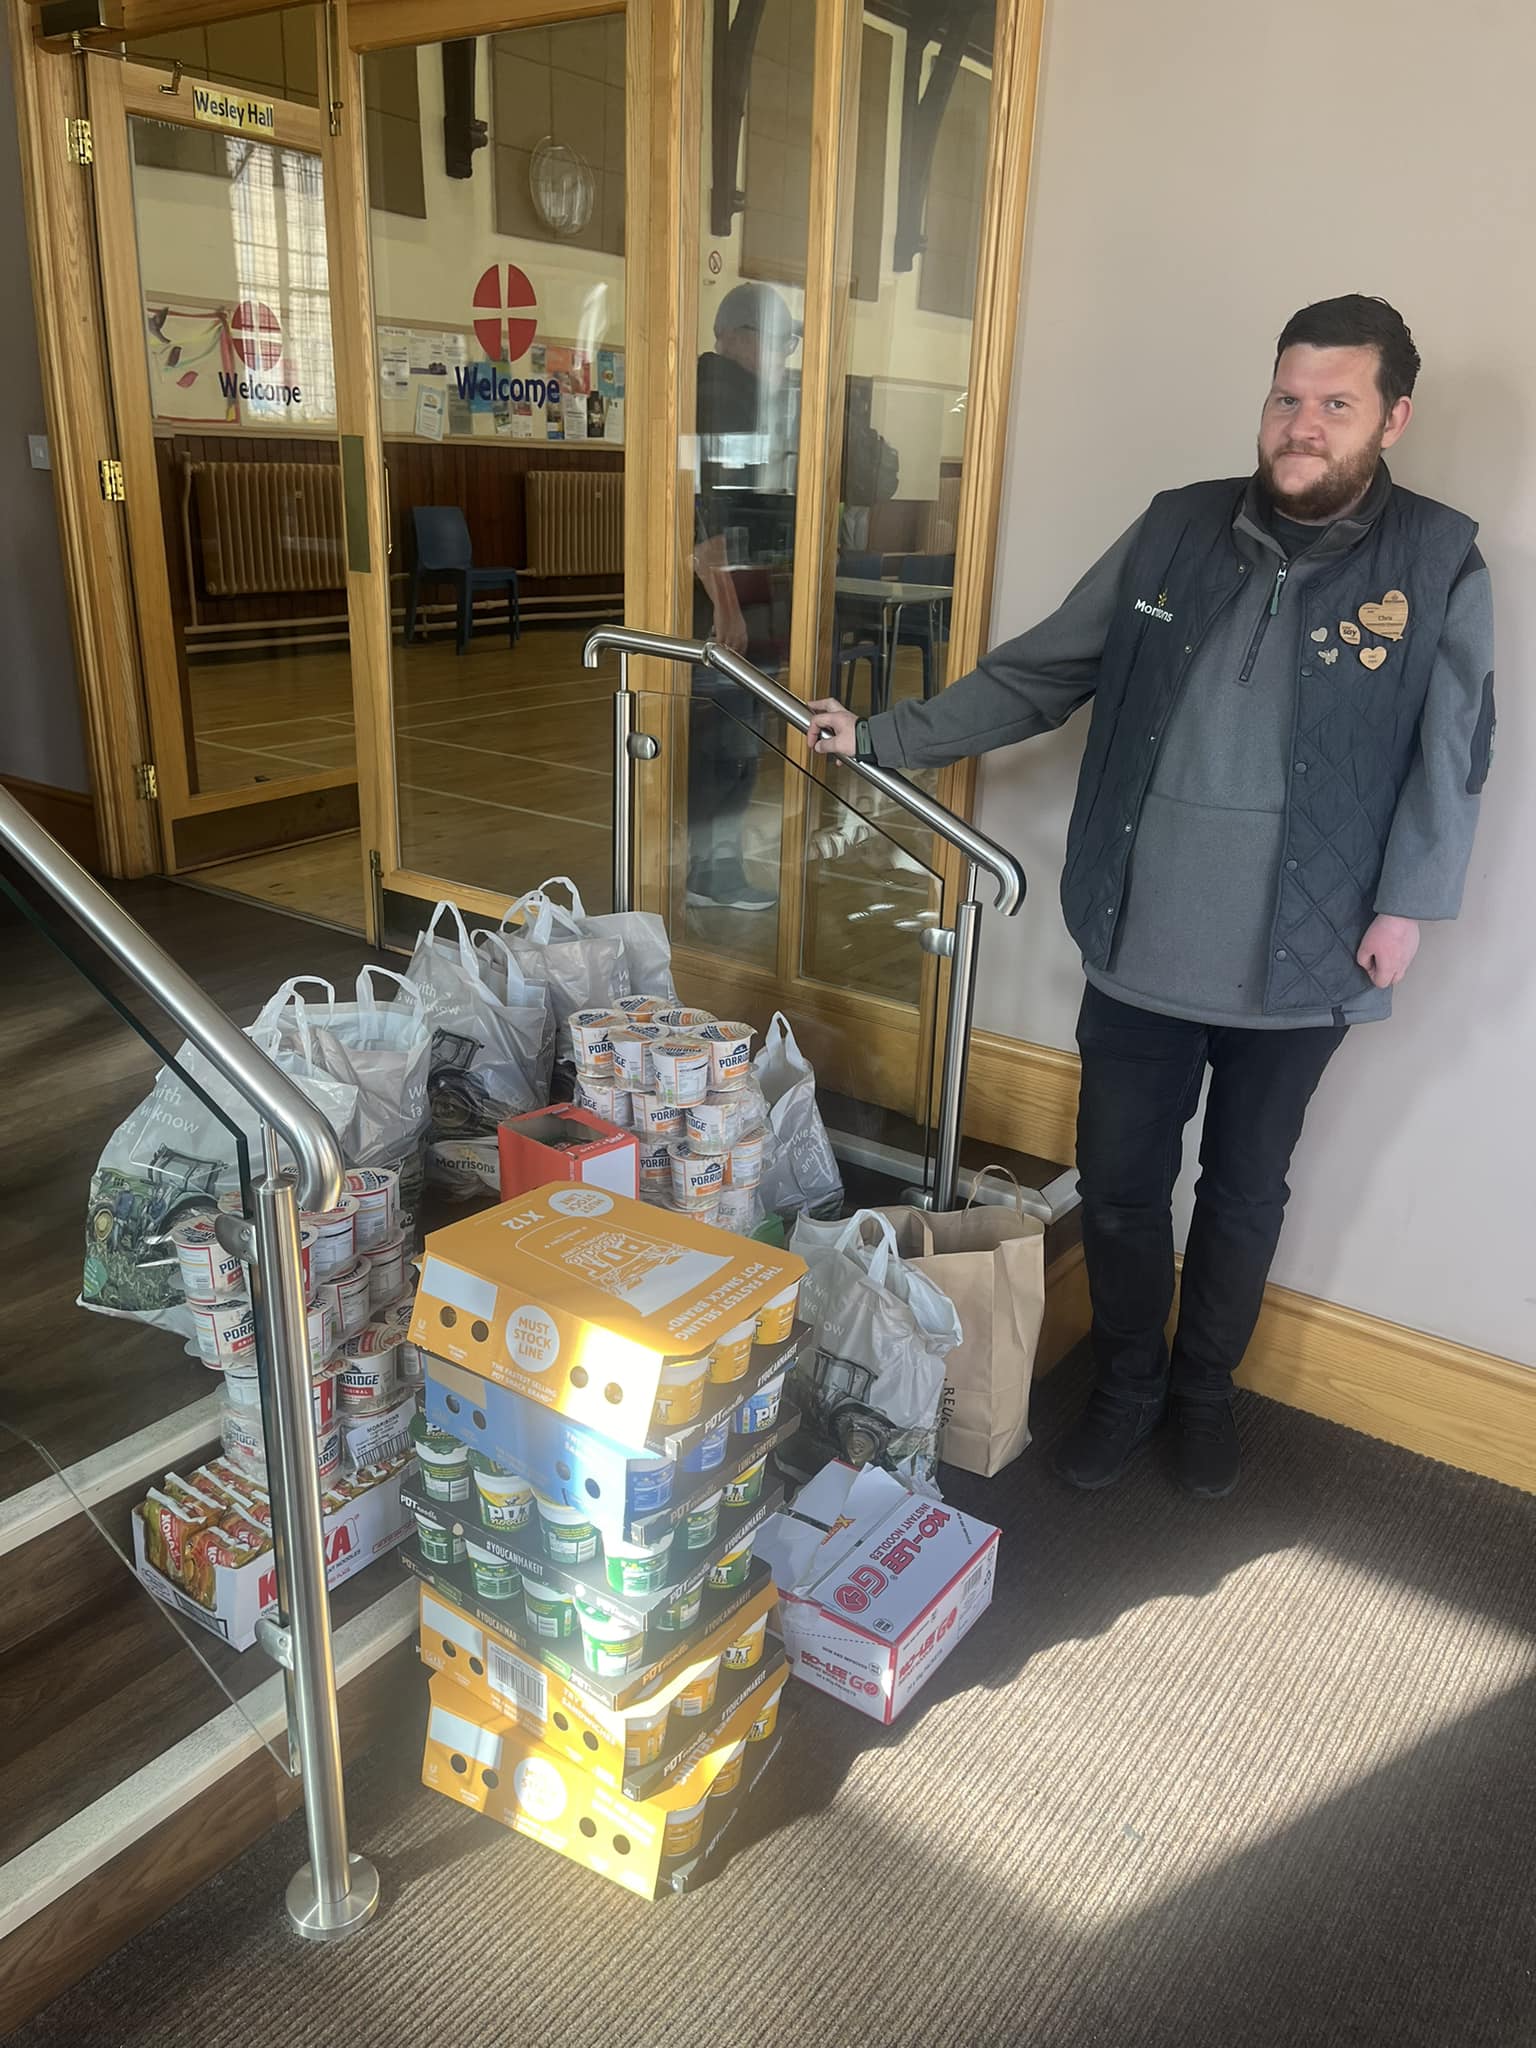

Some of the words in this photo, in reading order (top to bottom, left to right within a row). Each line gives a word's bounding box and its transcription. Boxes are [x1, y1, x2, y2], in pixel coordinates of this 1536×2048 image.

[194, 89, 245, 127] Wesley
[248, 103, 273, 127] Hall
[218, 371, 302, 406] Welcome
[455, 363, 560, 408] Welcome
[419, 981, 436, 997] ith
[588, 1041, 614, 1055] PORR
[650, 1109, 681, 1122] PORRI
[688, 1118, 707, 1132] IDGE
[435, 1158, 496, 1174] Morrisons
[690, 1172, 722, 1186] PORRID
[742, 1262, 764, 1279] POT
[757, 1265, 783, 1281] THE
[708, 1276, 744, 1302] SNACK
[721, 1279, 763, 1311] FASTEST
[223, 1323, 255, 1343] PORR
[517, 1316, 550, 1332] MUST
[674, 1308, 723, 1341] SELLING
[513, 1328, 552, 1350] STOCK
[518, 1344, 544, 1361] LINE
[704, 1407, 726, 1434] POT
[756, 1400, 780, 1422] PO
[236, 1432, 258, 1447] IDGE
[400, 1494, 418, 1510] POT
[902, 1502, 931, 1533] INSTANT
[869, 1528, 905, 1560] NOODLES
[880, 1507, 951, 1575] KO-LEE
[486, 1540, 543, 1576] #YOUCANMAKEIT
[670, 1580, 689, 1604] POT
[725, 1646, 752, 1661] OT
[642, 1660, 664, 1685] POT
[801, 1650, 848, 1682] KO-LEE
[664, 1750, 685, 1777] POT
